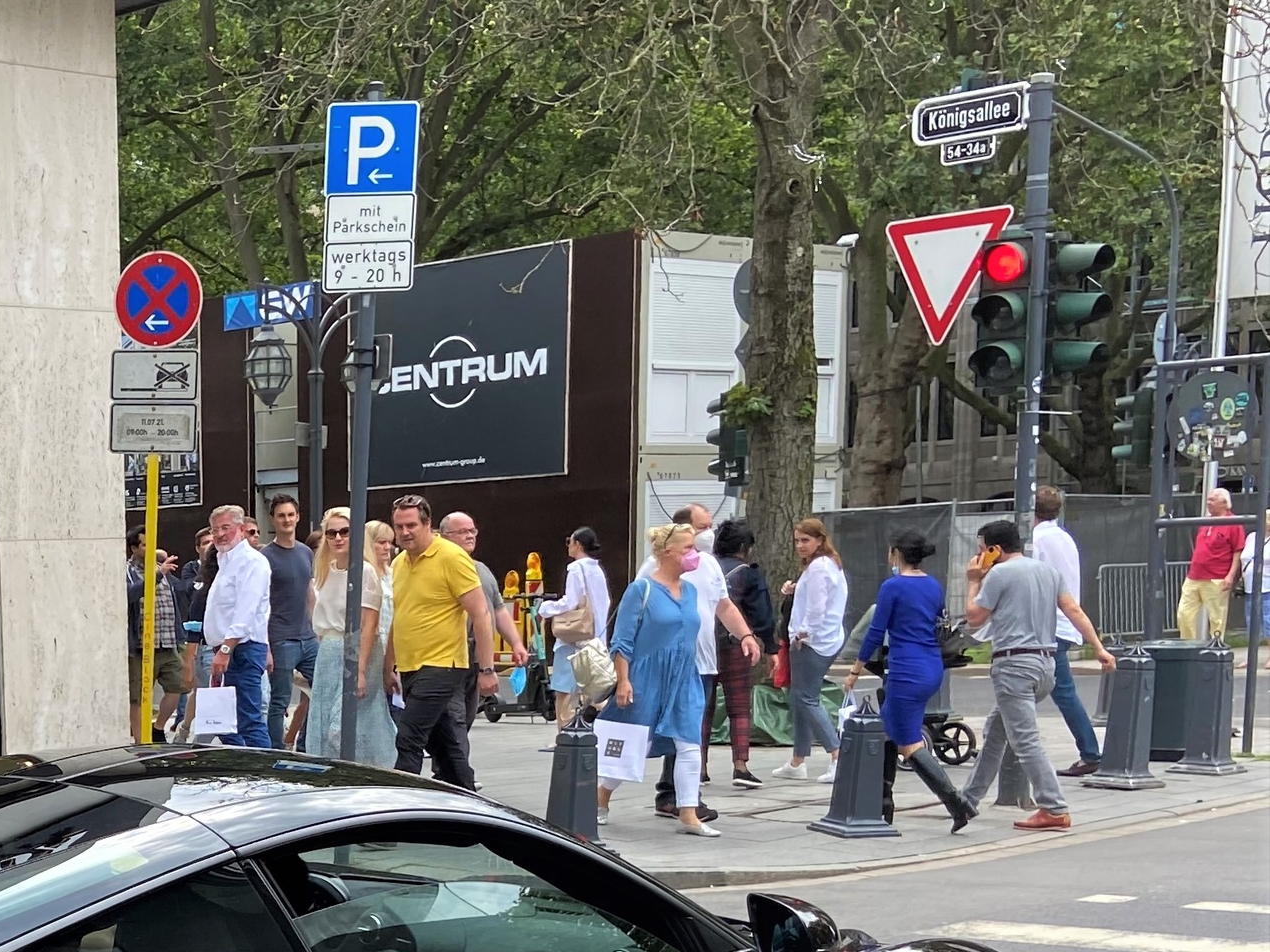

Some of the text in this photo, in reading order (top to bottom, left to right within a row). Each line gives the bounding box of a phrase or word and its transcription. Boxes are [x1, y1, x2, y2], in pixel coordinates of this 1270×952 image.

[928, 100, 1011, 131] Königsallee
[347, 115, 396, 186] P
[947, 141, 986, 159] 54-34a
[359, 204, 381, 218] mit
[332, 219, 406, 234] Parkschein
[331, 248, 406, 266] werktags
[334, 269, 343, 284] 9
[366, 268, 385, 283] 20
[392, 267, 402, 283] h
[378, 347, 548, 395] ENTRUM
